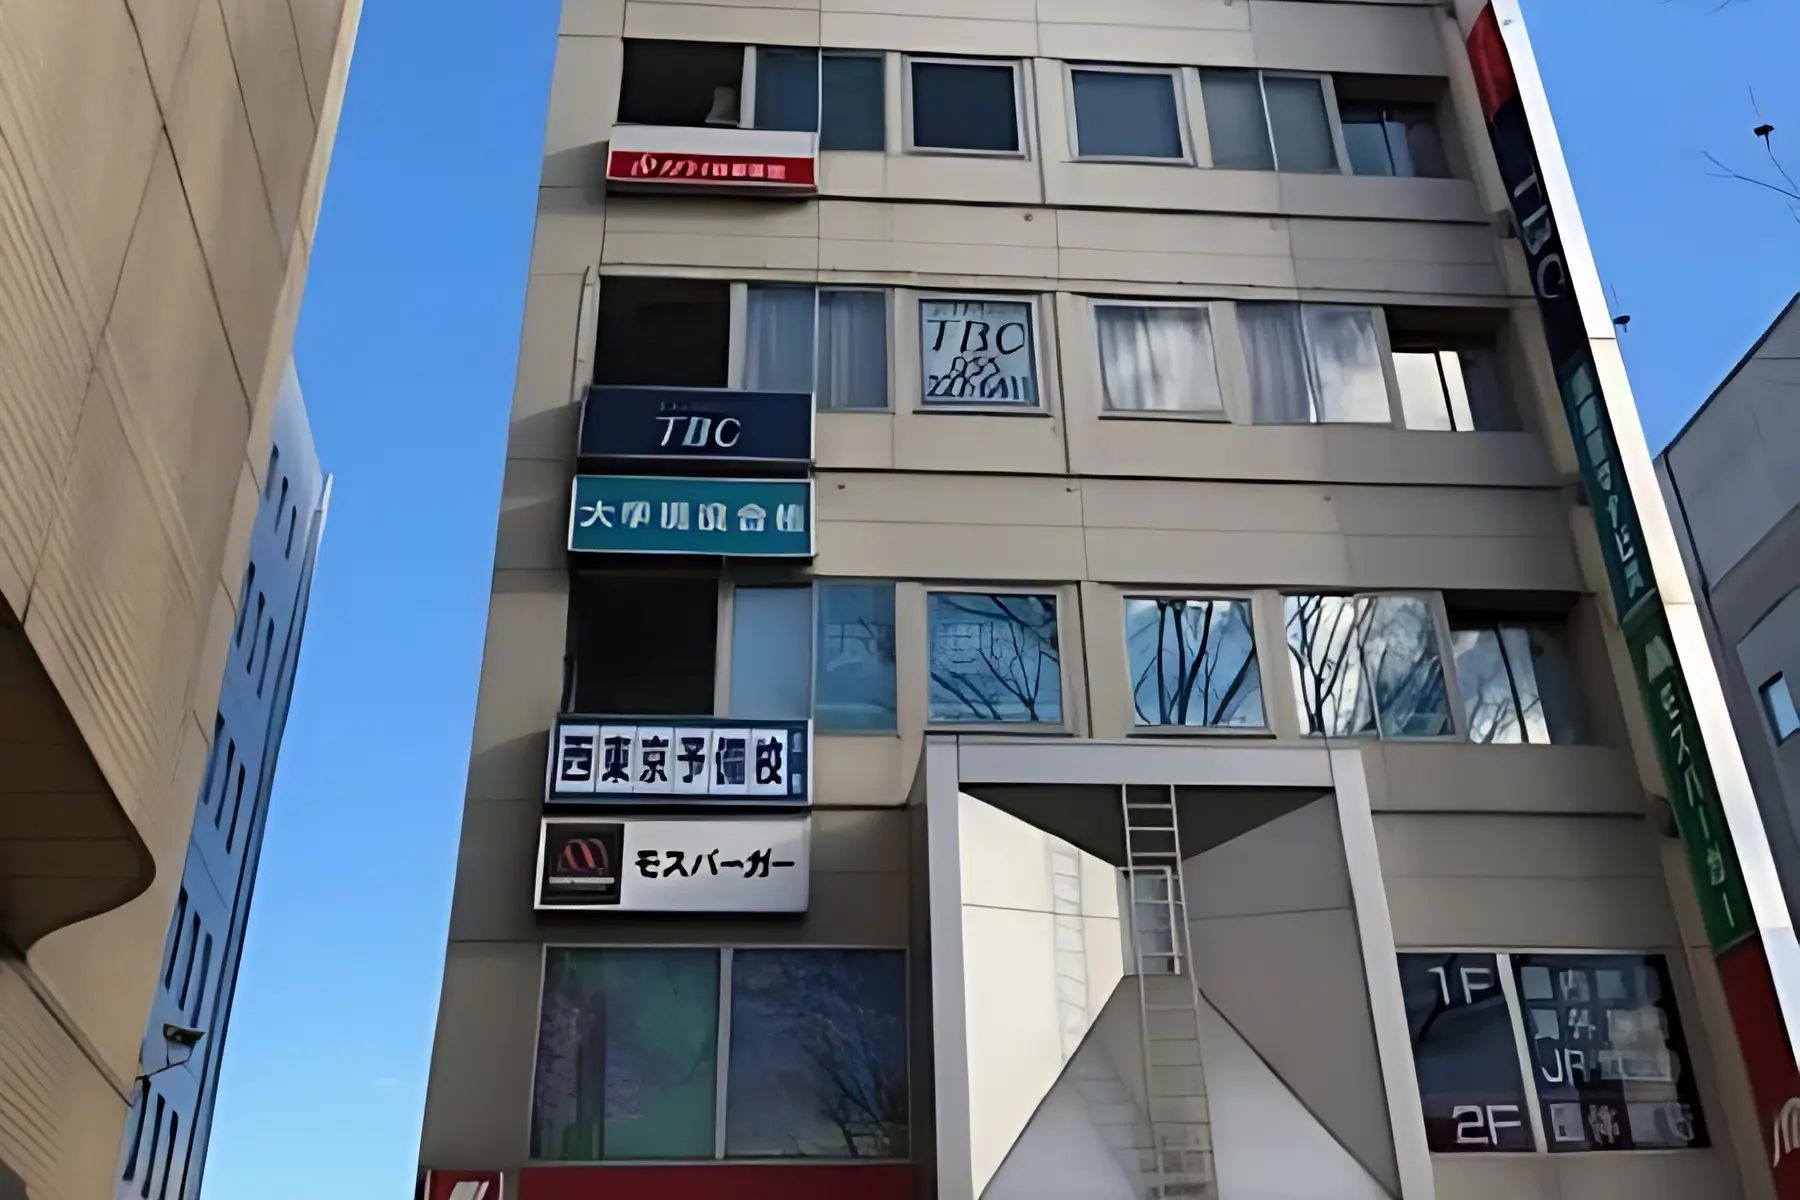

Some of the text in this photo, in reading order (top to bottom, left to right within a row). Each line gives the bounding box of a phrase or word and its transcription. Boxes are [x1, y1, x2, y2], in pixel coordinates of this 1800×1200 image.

[635, 848, 795, 878] モスバーガー
[1452, 1104, 1521, 1145] 2F
